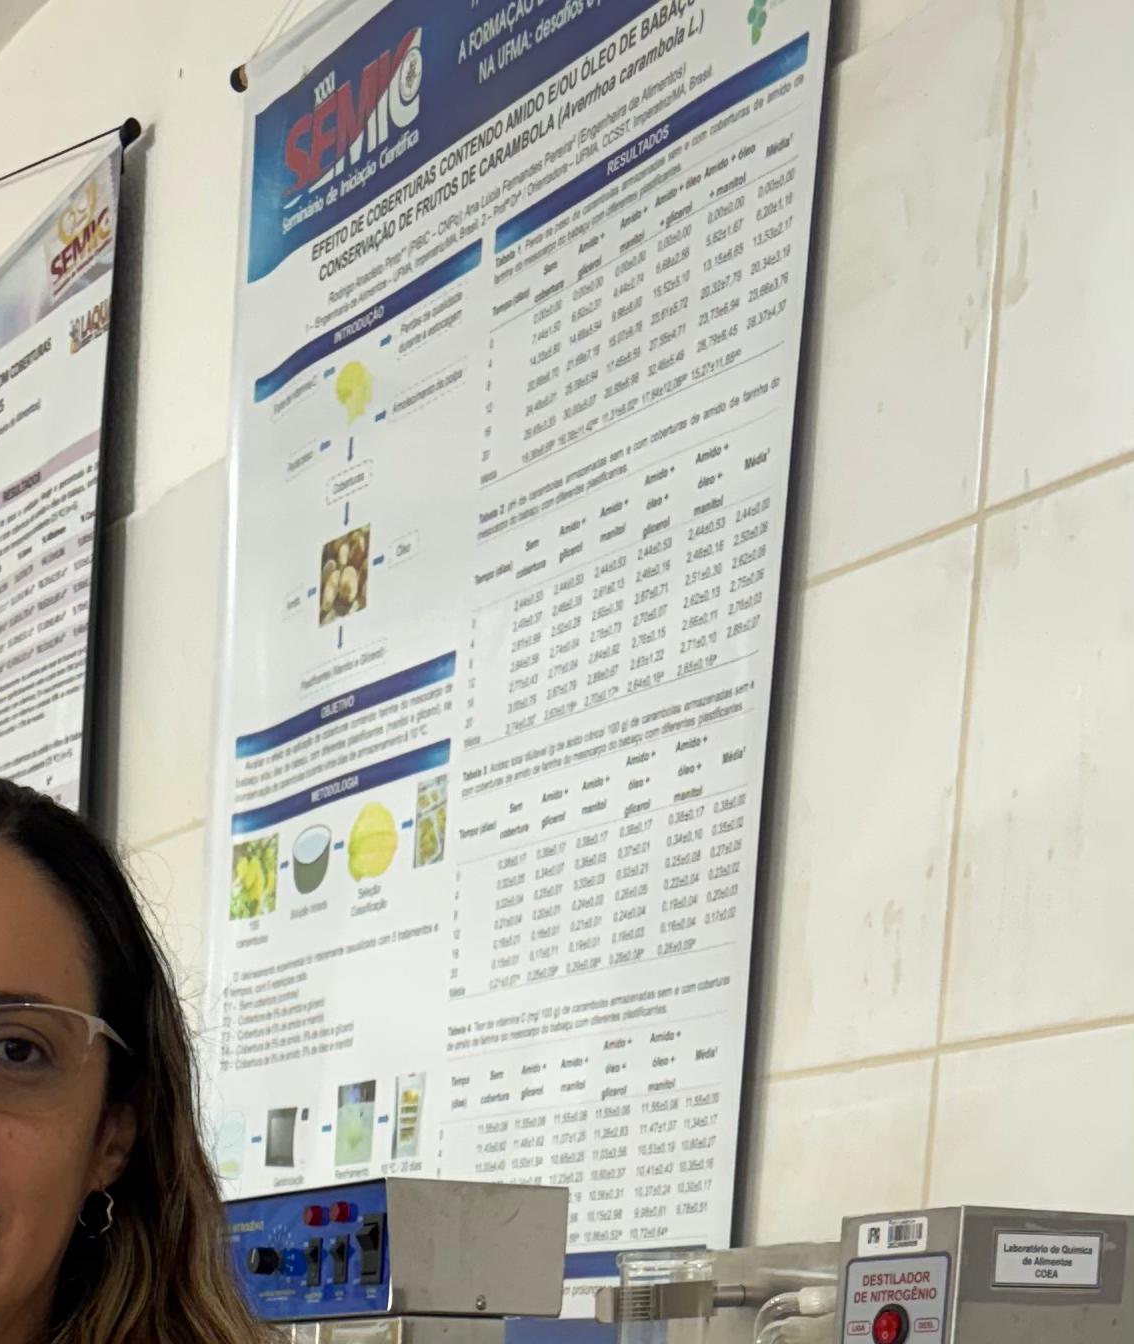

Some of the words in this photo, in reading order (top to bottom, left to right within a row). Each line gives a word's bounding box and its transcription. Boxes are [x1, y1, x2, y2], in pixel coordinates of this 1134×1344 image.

[478, 57, 496, 84] NA
[498, 35, 533, 70] UFMA:
[311, 226, 349, 261] EFEITO
[350, 214, 365, 238] DE
[366, 165, 437, 228] COBERTURAS
[439, 121, 504, 177] CONTENDO
[505, 92, 544, 133] AMIDO
[548, 68, 578, 104] E/OU
[581, 42, 615, 81] ÓLEO
[619, 27, 638, 55] DE
[319, 219, 396, 281] CONSERVAÇÃO
[398, 207, 414, 232] DE
[415, 177, 459, 216] FRUTOS
[461, 166, 476, 190] DE
[479, 114, 554, 177] CARAMBOLA
[558, 76, 616, 130] (Averrhoa
[619, 26, 685, 85] carambola
[687, 9, 704, 38] L.)
[606, 124, 670, 177] RESULTADOS
[333, 305, 385, 344] INTRODUÇÃO
[320, 695, 355, 719] OBJETIVO
[1003, 1243, 1048, 1253] Laboratório
[1050, 1245, 1060, 1254] de
[1022, 1257, 1032, 1266] de
[1034, 1257, 1073, 1266] Alimentos
[862, 1271, 930, 1287] DESTILADOR
[854, 1291, 867, 1304] DE
[870, 1286, 937, 1302] NITROGÊNIO
